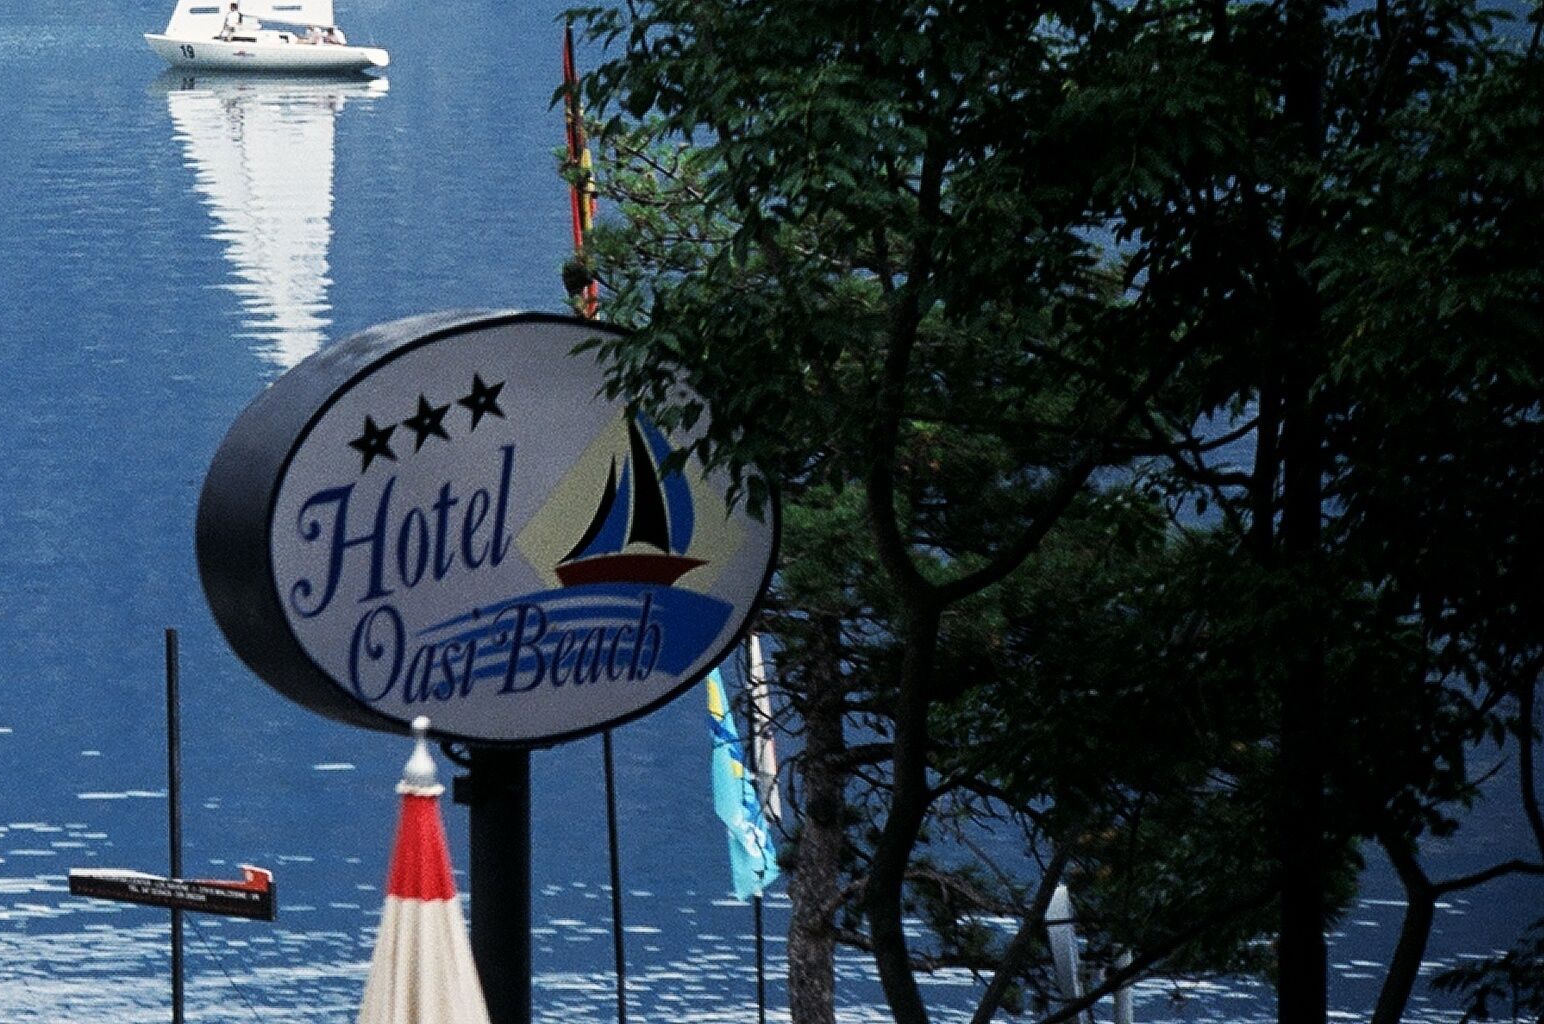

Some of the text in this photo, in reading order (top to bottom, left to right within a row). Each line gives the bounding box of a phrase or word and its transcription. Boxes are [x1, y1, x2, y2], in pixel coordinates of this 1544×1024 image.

[179, 44, 196, 59] 19
[290, 445, 515, 618] Hotel
[349, 592, 662, 704] Oasi Beach
